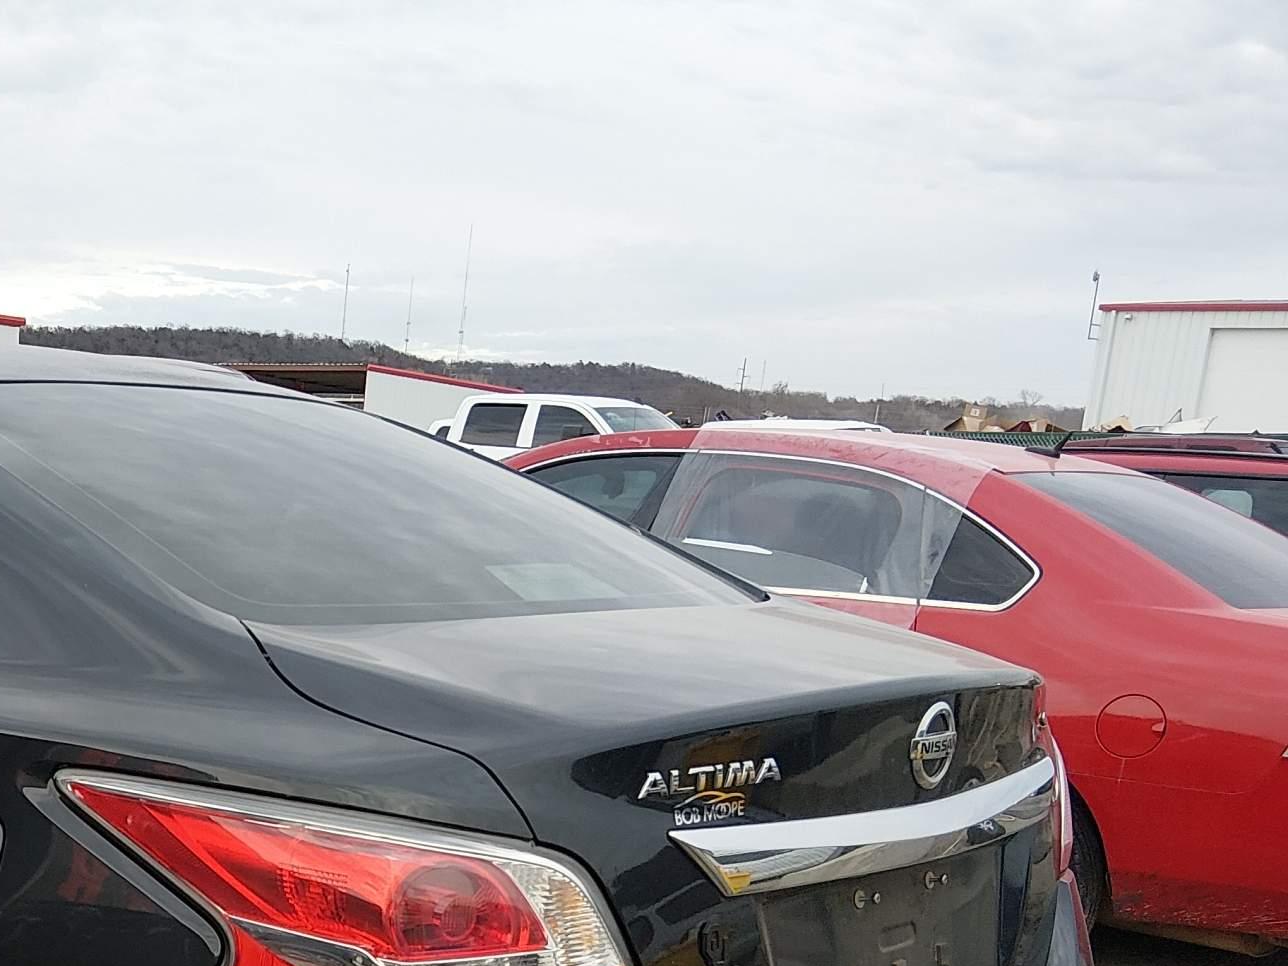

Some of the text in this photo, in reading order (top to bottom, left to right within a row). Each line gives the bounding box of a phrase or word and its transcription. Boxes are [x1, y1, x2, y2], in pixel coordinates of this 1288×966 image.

[919, 737, 955, 755] NISSA
[637, 757, 782, 799] ALTIMA
[674, 806, 701, 826] BOB
